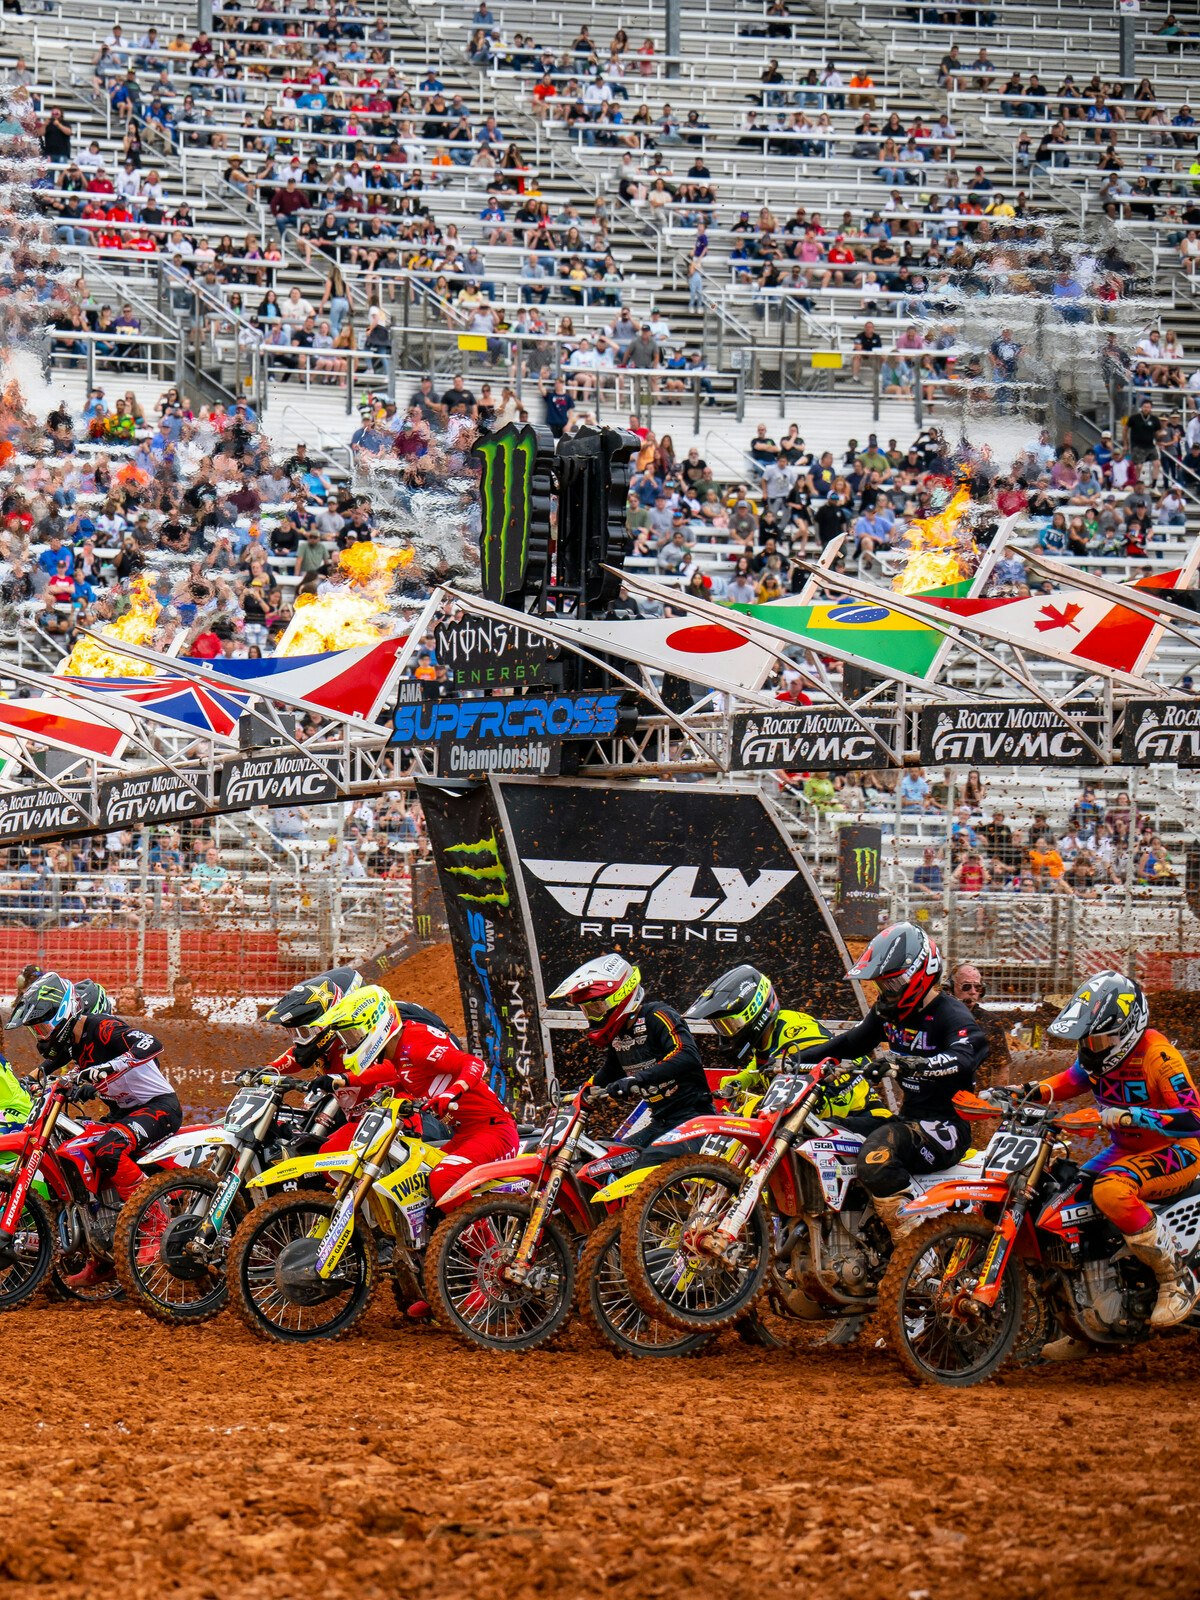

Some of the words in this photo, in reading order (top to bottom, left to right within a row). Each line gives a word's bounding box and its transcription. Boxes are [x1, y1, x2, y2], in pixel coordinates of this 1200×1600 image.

[457, 663, 541, 684] ENERGY
[400, 683, 422, 703] AMA
[391, 695, 621, 742] SUPERCROSS
[450, 742, 550, 772] Championship
[521, 859, 799, 923] FLY
[580, 922, 738, 942] RACING
[359, 1036, 384, 1069] PROGRESSIVE
[1102, 1078, 1149, 1103] XR
[226, 1095, 268, 1125] 27
[679, 1128, 707, 1139] MAXXIS
[315, 1159, 348, 1168] PROGRESSIVE
[988, 1135, 1038, 1171] 129
[1129, 1143, 1198, 1181] FXR
[5, 1183, 23, 1227] DUNLOP
[220, 1181, 239, 1211] MOTOREX
[406, 1201, 428, 1213] SUZUKI
[727, 1180, 754, 1219] MAXXIS
[334, 1229, 352, 1254] GALFER
